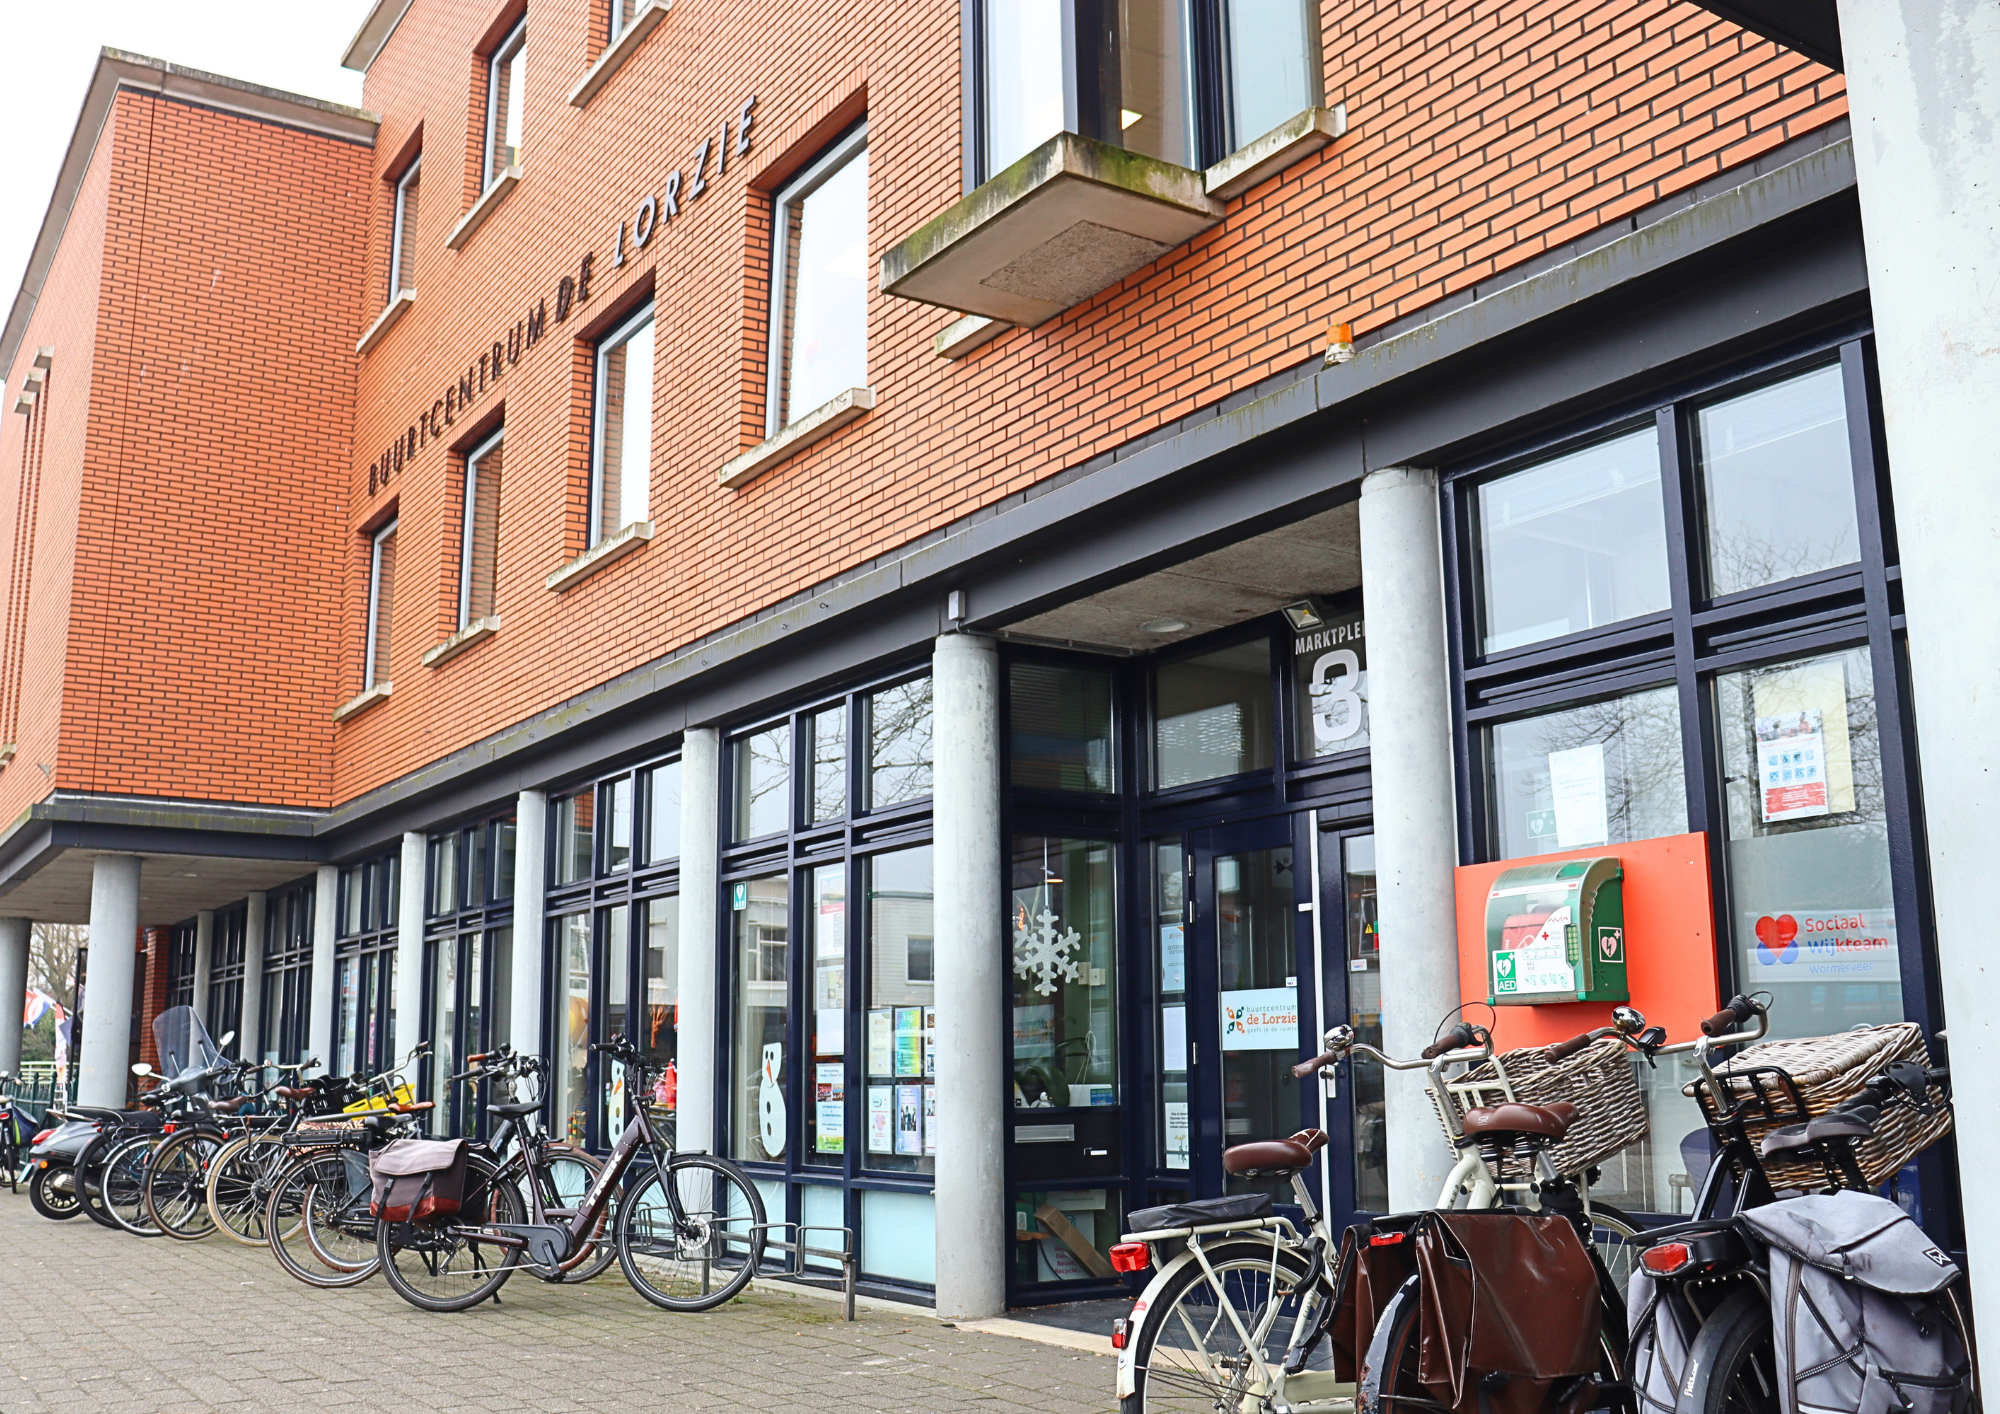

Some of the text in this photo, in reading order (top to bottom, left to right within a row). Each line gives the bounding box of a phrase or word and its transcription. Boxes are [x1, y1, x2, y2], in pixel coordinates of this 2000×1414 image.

[368, 95, 757, 496] BUURTCENTRUM DE LORZIE
[1312, 648, 1362, 742] 3
[1805, 913, 1866, 933] Sociaal
[1807, 937, 1889, 957] Wijkteam
[1809, 962, 1874, 974] Wormerveer
[1498, 980, 1517, 991] AED
[1246, 1004, 1297, 1013] buurtcentrum
[1246, 1012, 1297, 1025] de Lorzie
[585, 1150, 623, 1208] TREK
